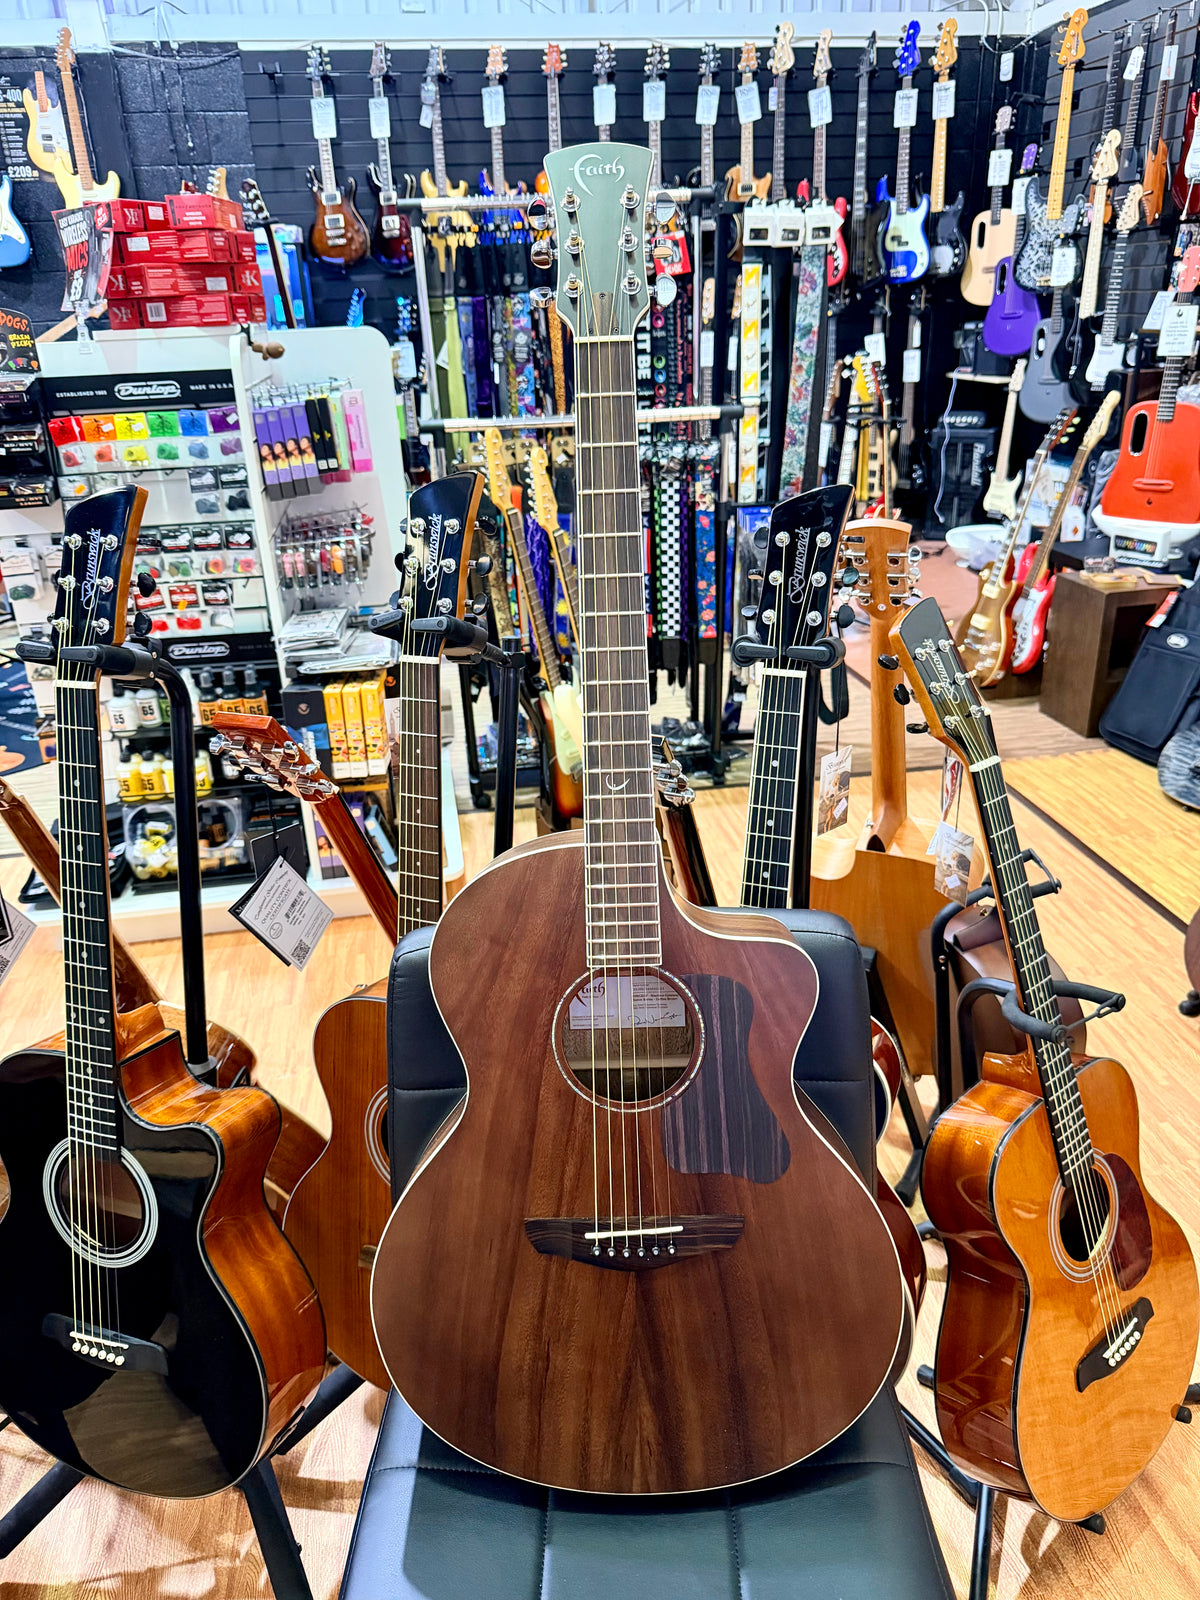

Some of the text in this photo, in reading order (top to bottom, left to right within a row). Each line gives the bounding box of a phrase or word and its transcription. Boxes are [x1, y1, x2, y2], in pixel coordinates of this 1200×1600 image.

[569, 154, 624, 196] Faith
[60, 220, 88, 248] WIRELESS
[66, 240, 88, 273] MICS
[70, 278, 84, 302] £8
[116, 382, 179, 398] Dunlop
[971, 442, 985, 486] Randall
[422, 512, 442, 590] Brunswick
[786, 526, 811, 604] Brunswick
[80, 528, 101, 609] Brunswick
[171, 644, 228, 658] Dunlop
[142, 706, 154, 716] 65
[261, 902, 277, 924] QUALITY
[269, 889, 291, 920] CERTIFICATE
